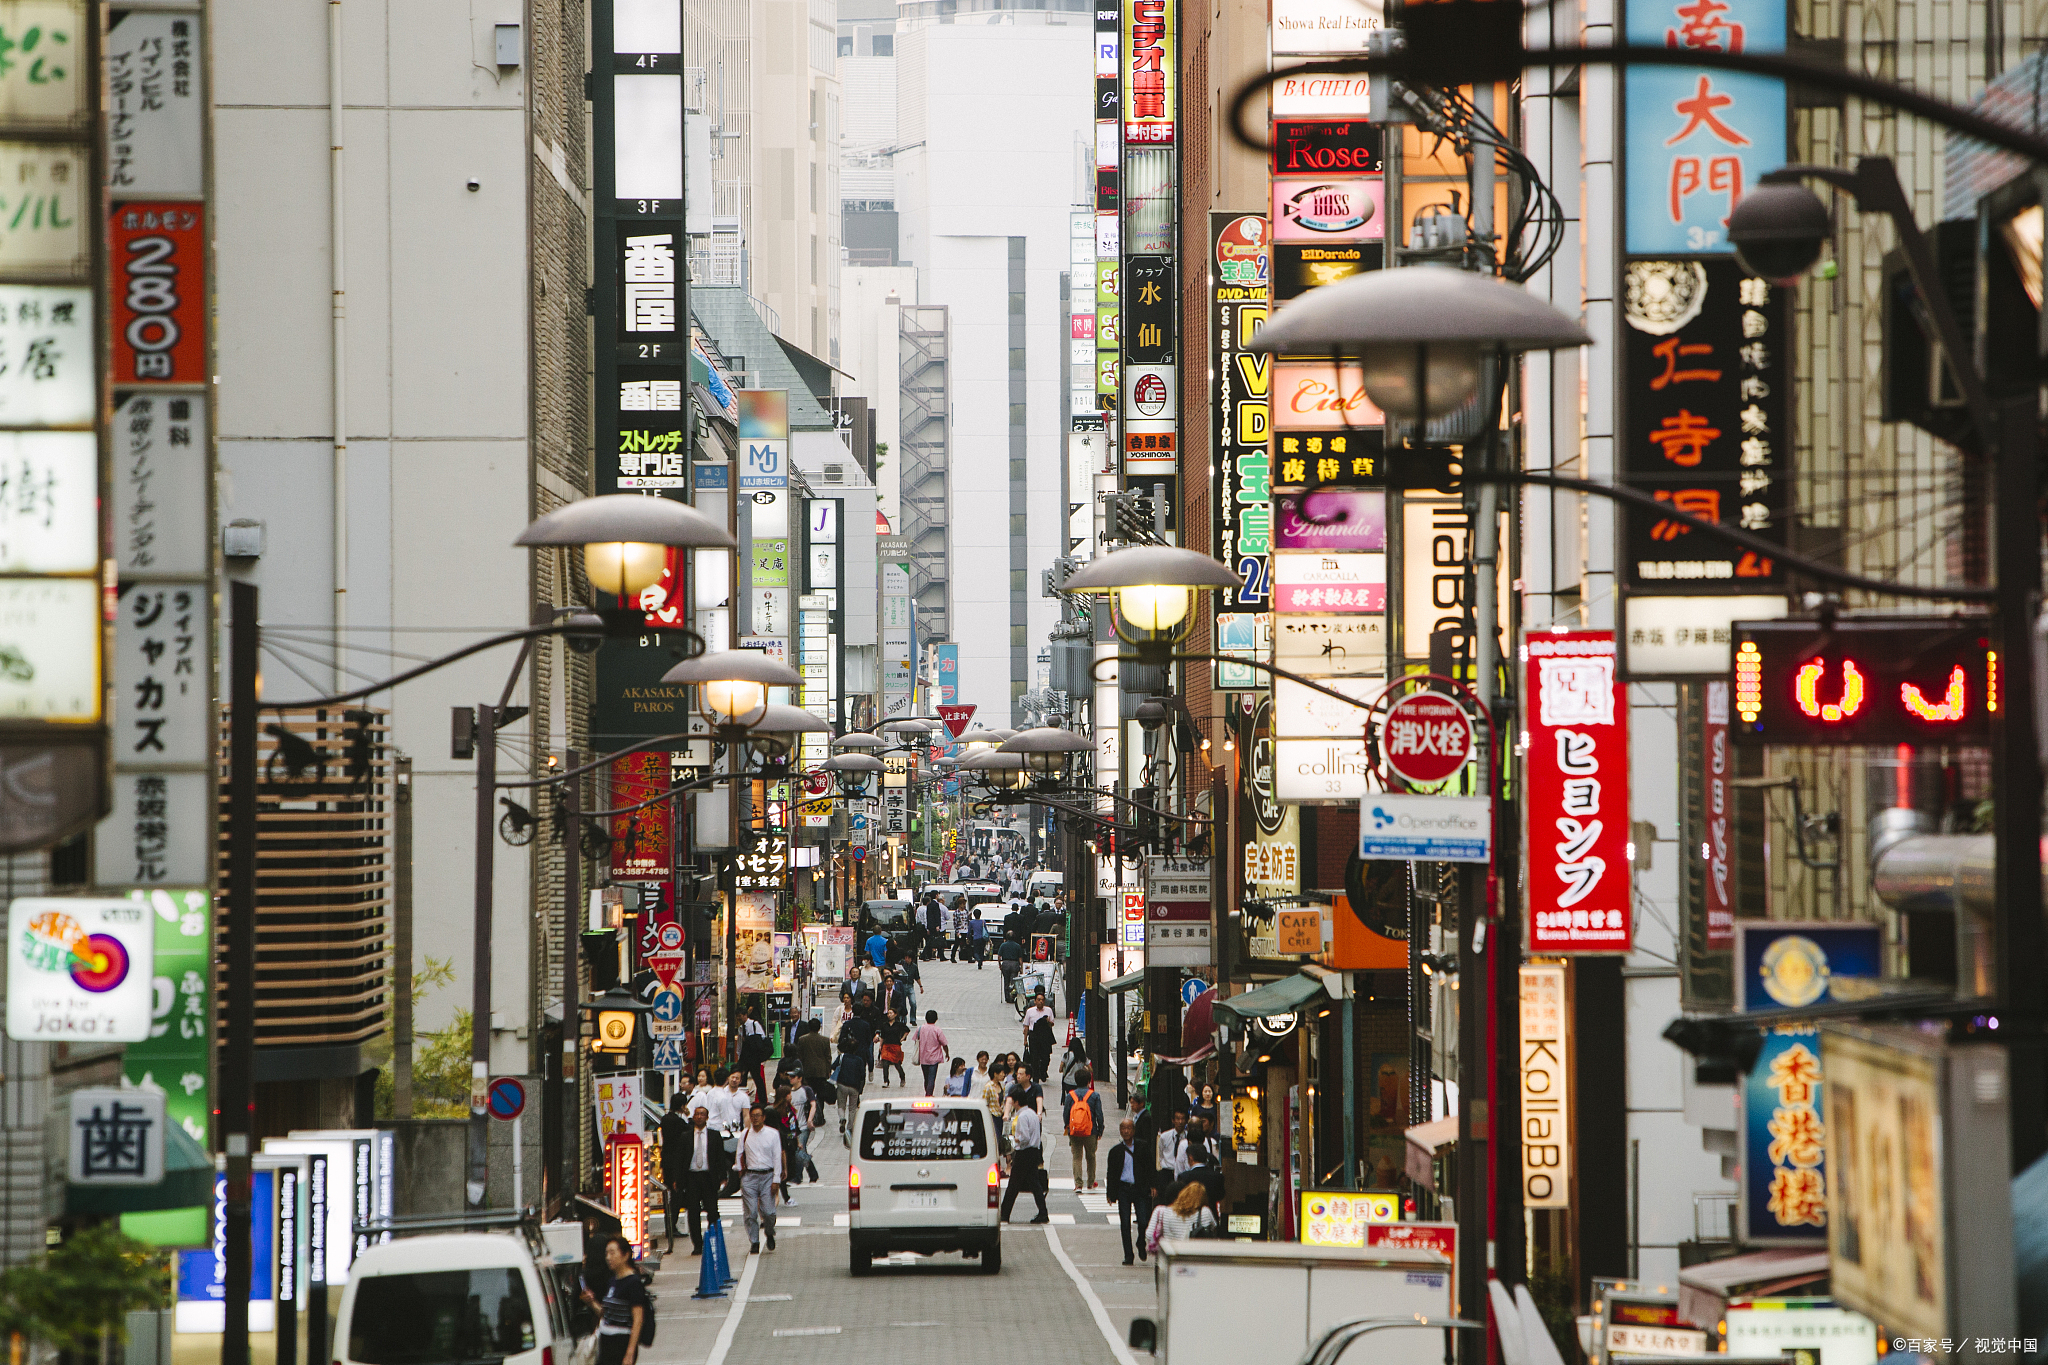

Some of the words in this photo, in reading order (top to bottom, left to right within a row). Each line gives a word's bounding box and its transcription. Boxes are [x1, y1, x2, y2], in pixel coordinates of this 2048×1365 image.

[1277, 15, 1314, 30] Showa
[1318, 15, 1342, 30] Real
[1345, 15, 1379, 30] Estate
[635, 54, 659, 69] 4F
[1132, 0, 1166, 118] ビデオ鑑賞
[1664, 0, 1752, 236] 南大門
[1126, 124, 1173, 141] 受付5F
[1336, 123, 1351, 136] of
[1286, 138, 1370, 169] Rose
[1374, 160, 1383, 171] 5
[637, 200, 661, 214] 3F
[122, 212, 197, 230] ホルモン
[1374, 223, 1382, 234] 5
[1144, 240, 1171, 251] AUN
[1300, 248, 1362, 261] ElDorado
[1135, 268, 1164, 278] クラブ
[624, 233, 676, 333] 番屋
[126, 236, 180, 380] 280円
[1137, 281, 1163, 348] 水仙
[638, 344, 662, 358] 2F
[1164, 356, 1173, 364] 3F
[619, 380, 682, 411] 番屋
[1220, 352, 1231, 447] RELAXATION
[1289, 378, 1367, 414] Ciel
[618, 430, 683, 452] ストレッチ
[1130, 435, 1171, 450] 吉野家
[618, 453, 684, 476] 専門店
[742, 477, 785, 488] MJ赤坂ビル
[1221, 449, 1232, 527] INTERNET
[756, 492, 773, 503] 5F
[879, 541, 908, 549] AKASAKA
[1221, 530, 1234, 606] MAGANE
[1302, 572, 1360, 582] CARACALLA
[1377, 597, 1385, 610] 2
[174, 591, 193, 696] ライブバー
[621, 687, 686, 699] AKASAKA
[632, 702, 675, 713] PAROS
[1397, 704, 1417, 717] FIRE
[1418, 704, 1457, 717] HYDRANT
[943, 711, 970, 721] 止まれ
[1389, 719, 1467, 757] 消火栓
[1298, 747, 1368, 775] collins
[1324, 780, 1342, 793] 33
[885, 795, 905, 832] 寺子屋
[1244, 840, 1297, 886] 完全防音
[612, 867, 670, 876] 03-3587-4786
[1281, 914, 1317, 929] CAFÉ
[1535, 909, 1624, 929] 24時間営業
[1295, 929, 1305, 938] de
[1287, 936, 1312, 947] CRIÉ
[656, 961, 677, 971] 止まれ
[597, 1083, 616, 1138] 通い放
[1524, 1038, 1560, 1200] KollaBo
[77, 1103, 154, 1177] 歯
[1766, 1042, 1828, 1228] 香港楼
[1328, 1198, 1371, 1219] 韓国
